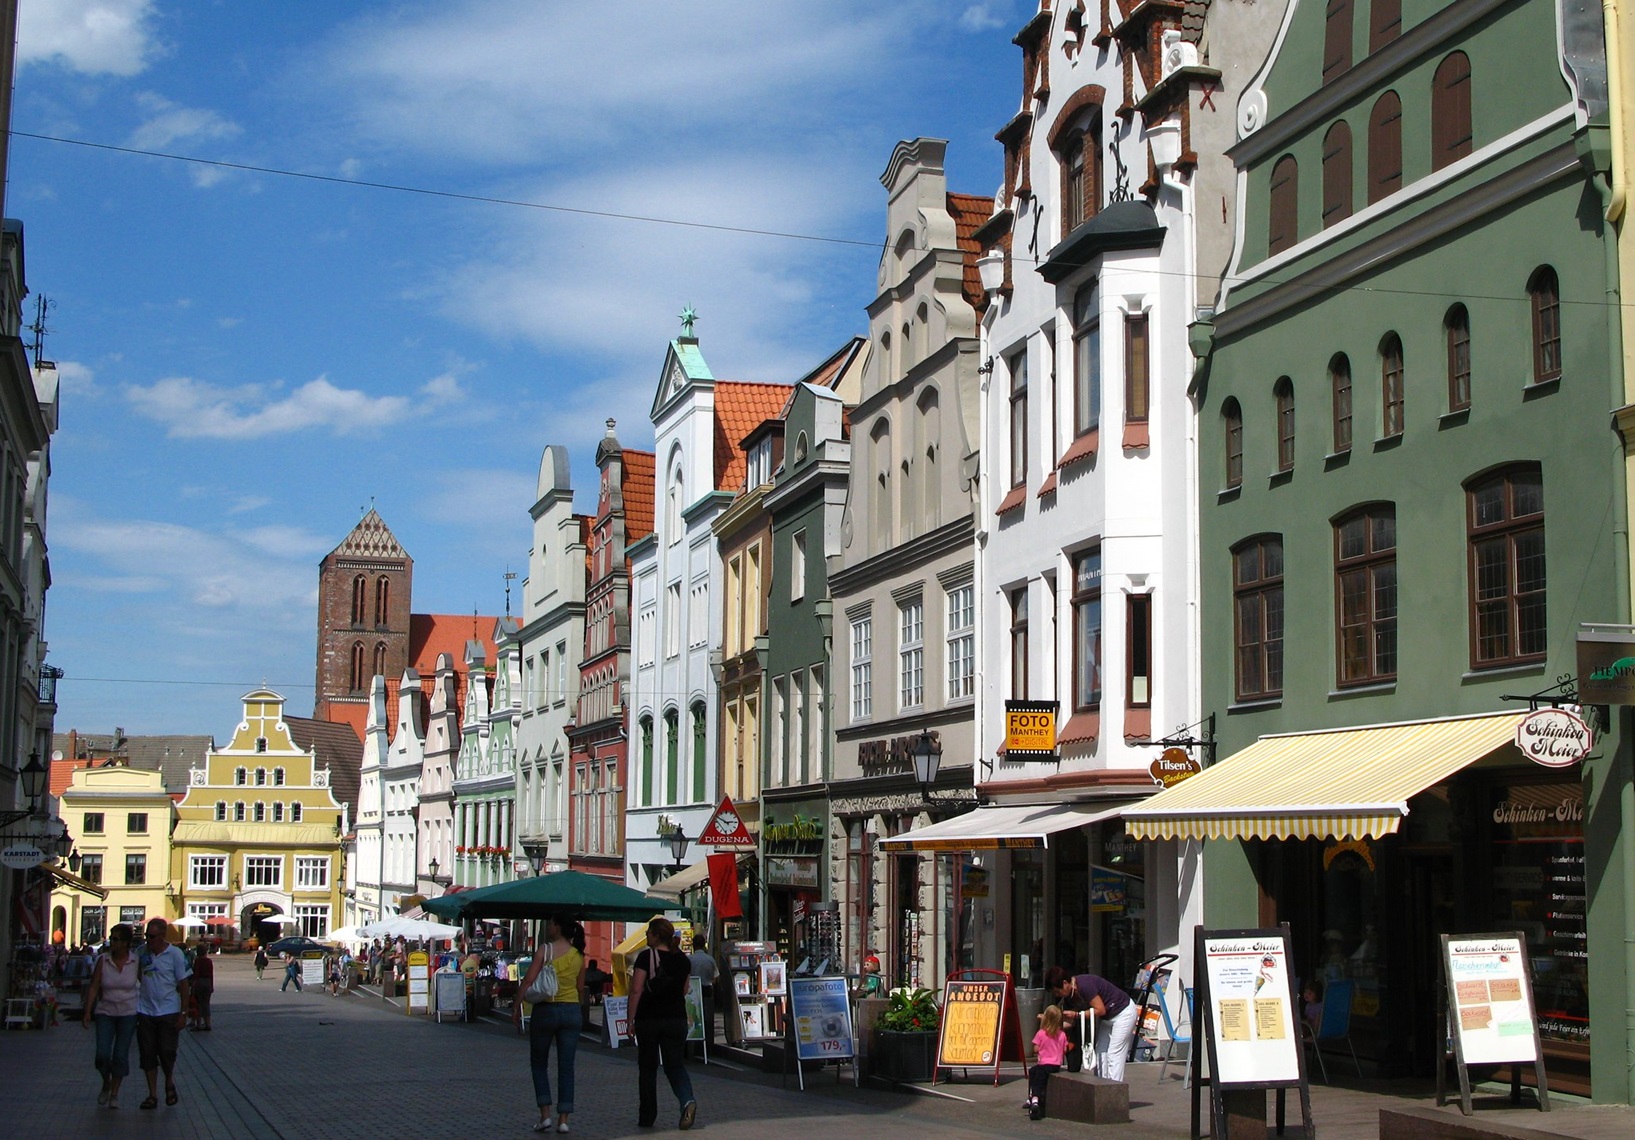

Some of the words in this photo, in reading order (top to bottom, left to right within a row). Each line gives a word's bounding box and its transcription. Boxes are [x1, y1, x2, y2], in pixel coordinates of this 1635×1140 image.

[1010, 715, 1050, 727] FOTO
[1010, 728, 1050, 736] MANTHEY
[1526, 720, 1584, 740] Schinken
[1530, 738, 1580, 757] Meier
[1158, 760, 1193, 771] Tilsen's
[1493, 801, 1547, 824] Schinken
[704, 836, 750, 844] DUGENA
[1210, 944, 1246, 953] Schinken
[1252, 942, 1280, 951] Meier
[949, 992, 1001, 1001] ANGEBOT
